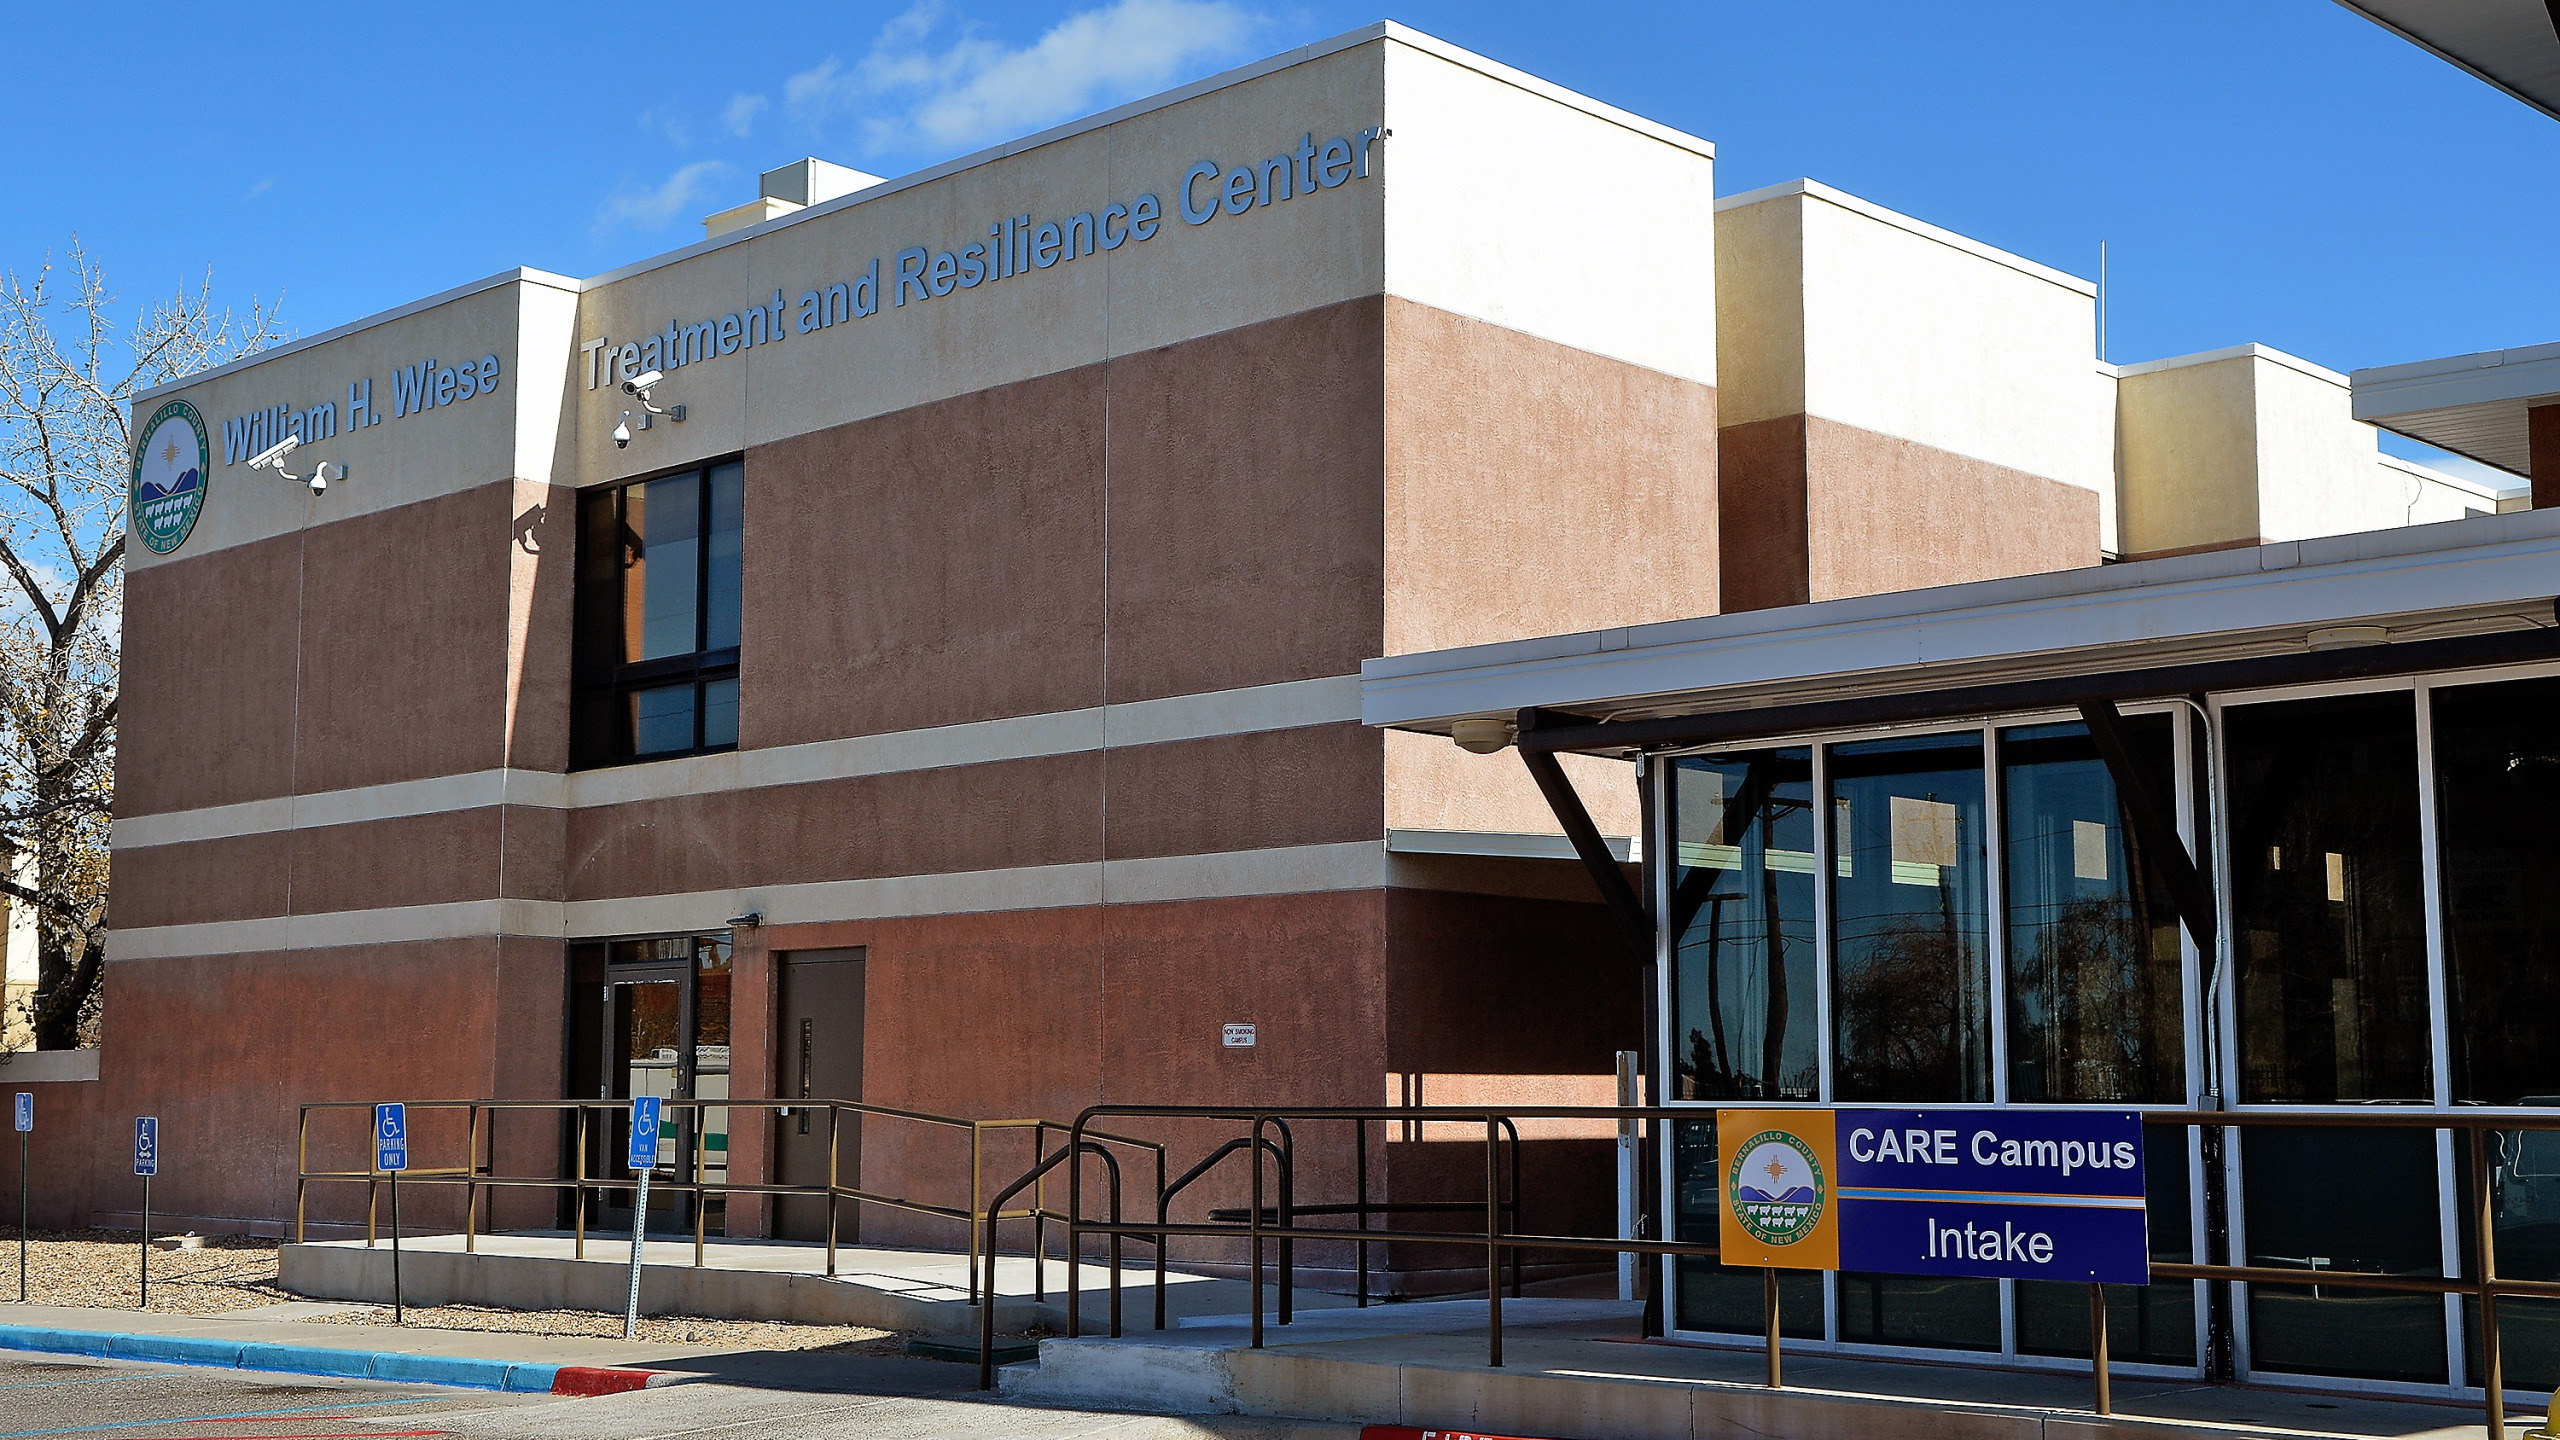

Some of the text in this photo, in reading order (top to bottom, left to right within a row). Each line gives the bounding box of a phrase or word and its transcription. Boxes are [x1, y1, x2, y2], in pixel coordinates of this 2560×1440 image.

[581, 126, 1382, 390] Treatment and Resilience Center
[222, 354, 500, 466] William H. Wiese
[135, 404, 207, 469] BERNALILLO COUNTY
[134, 486, 204, 550] STATE OF NEW MEXICO
[380, 1138, 405, 1151] PARKING
[384, 1153, 400, 1166] ONLY
[631, 1154, 655, 1164] ACCESSIBLE
[639, 1144, 648, 1152] VAN
[1732, 1132, 1822, 1176] BERNALILLO COUNTY
[1849, 1128, 2136, 1177] CARE Campus
[1732, 1199, 1822, 1244] STATE OF NEW MEXICO
[1928, 1218, 2054, 1264] Intake
